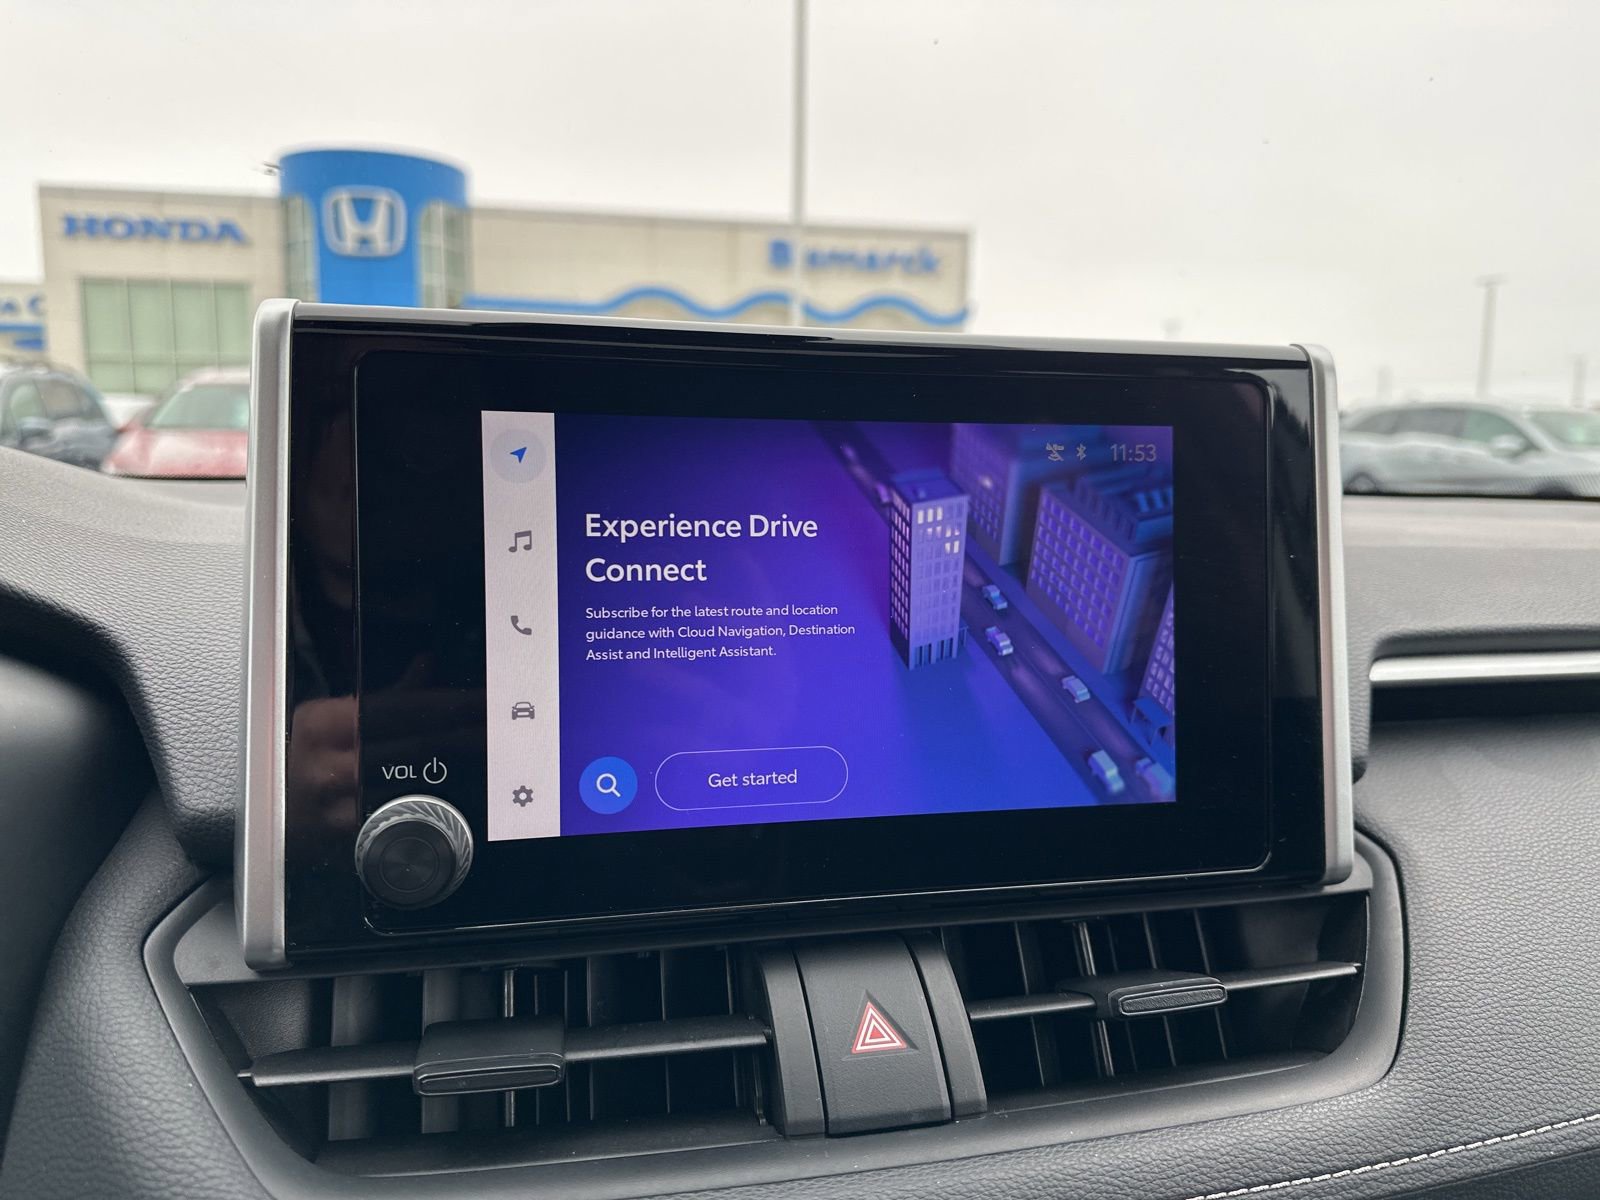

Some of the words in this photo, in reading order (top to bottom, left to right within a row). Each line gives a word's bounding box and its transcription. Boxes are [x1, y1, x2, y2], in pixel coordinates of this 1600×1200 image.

[63, 213, 249, 243] HONDA
[769, 240, 940, 274] Bsmarck
[1110, 443, 1157, 462] 11:53
[585, 513, 742, 543] Experience
[749, 513, 818, 538] Drive
[585, 557, 707, 582] Connect
[585, 606, 649, 619] Subscribe
[651, 606, 669, 618] for
[671, 606, 692, 617] the
[694, 605, 729, 617] latest
[731, 605, 763, 616] route
[765, 604, 789, 616] and
[792, 604, 838, 616] location
[586, 628, 646, 642] guidance
[648, 627, 675, 639] with
[677, 626, 715, 638] Cloud
[717, 625, 787, 640] Navigation,
[789, 624, 856, 636] Destination
[586, 648, 624, 661] Assist
[625, 648, 650, 660] and
[653, 646, 716, 662] Intelligent
[719, 645, 777, 658] Assistant.
[382, 765, 417, 781] VOL
[708, 772, 738, 789] Get
[741, 769, 799, 788] started
